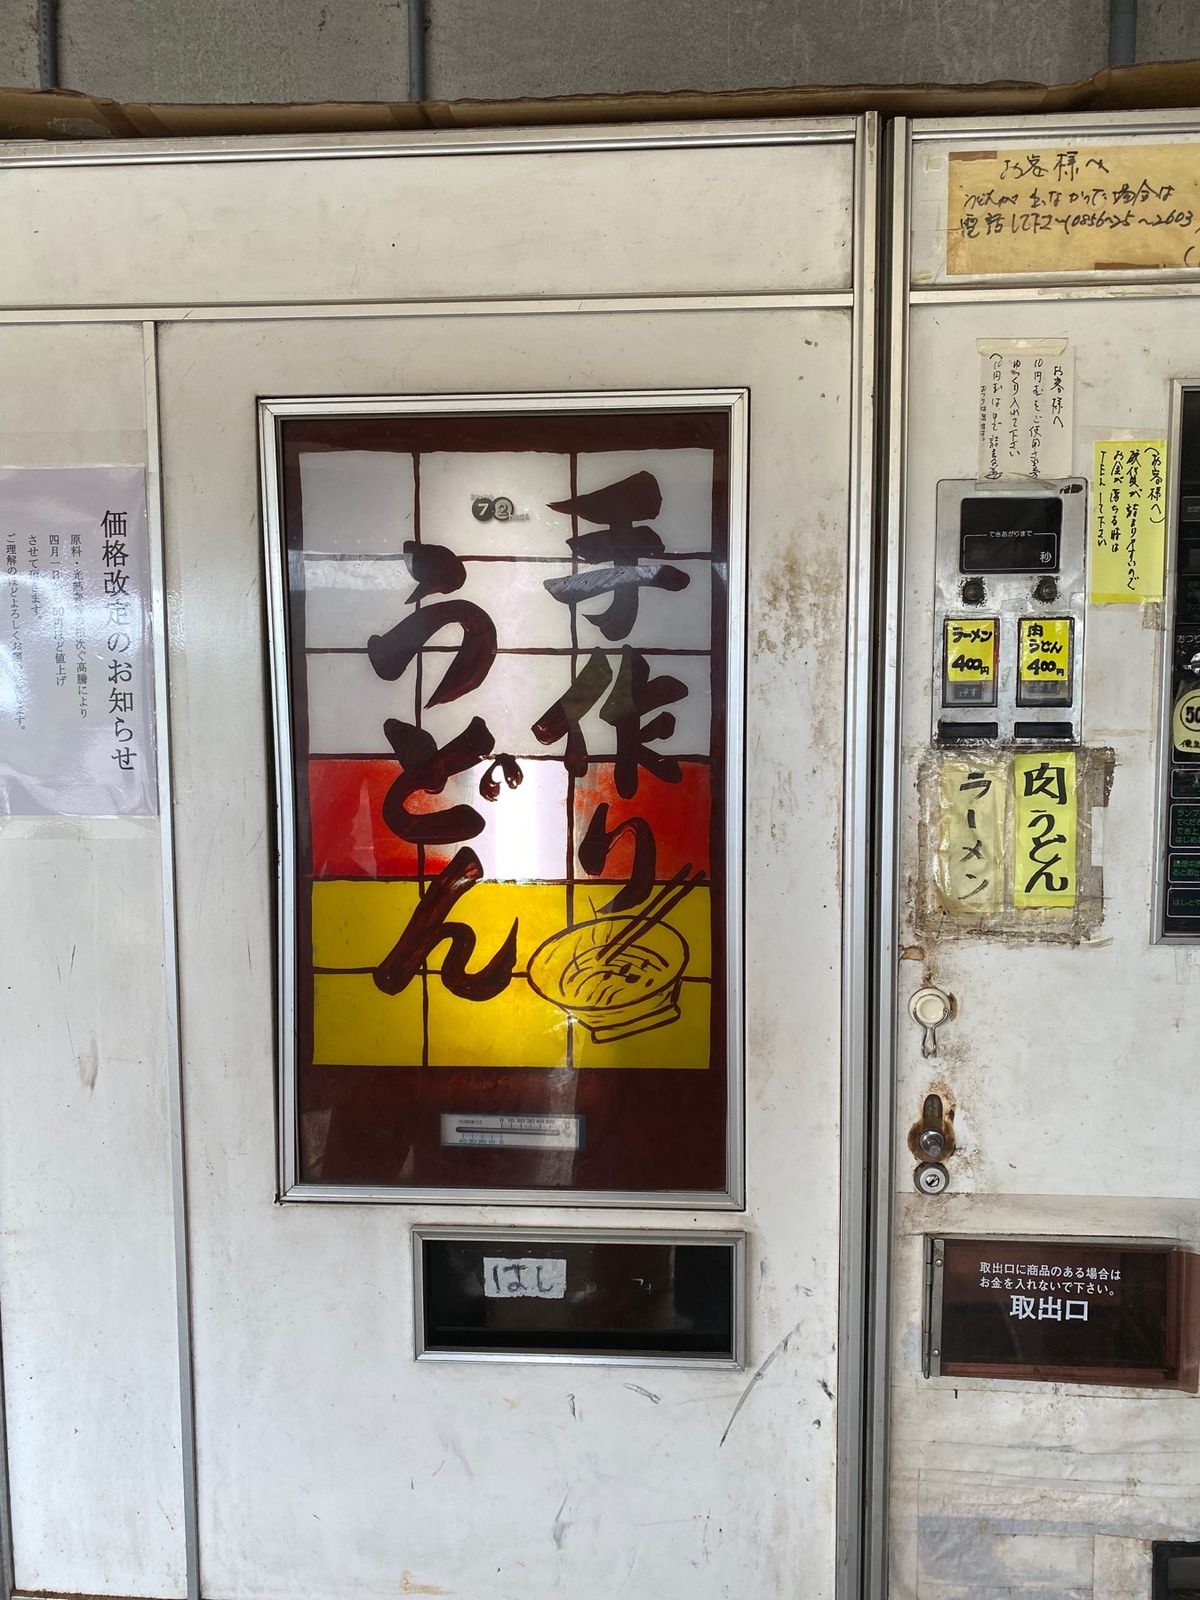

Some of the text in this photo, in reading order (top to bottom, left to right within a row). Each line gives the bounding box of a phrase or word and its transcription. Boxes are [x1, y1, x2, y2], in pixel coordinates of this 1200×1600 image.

[1040, 551, 1052, 563] 秒
[100, 510, 137, 770] 価格改定のお知らせ
[952, 626, 993, 643] ラーメン
[1028, 639, 1063, 654] うどん
[951, 654, 990, 676] 400円
[1027, 658, 1065, 676] 400円
[368, 541, 524, 1002] うどん
[958, 772, 992, 900] ラーメン
[1023, 762, 1069, 893] 肉うどん
[979, 1261, 1122, 1281] 取出口に商品のある場合は
[979, 1276, 1116, 1296] お金を入れないで下さい。
[1009, 1294, 1089, 1322] 取出口
